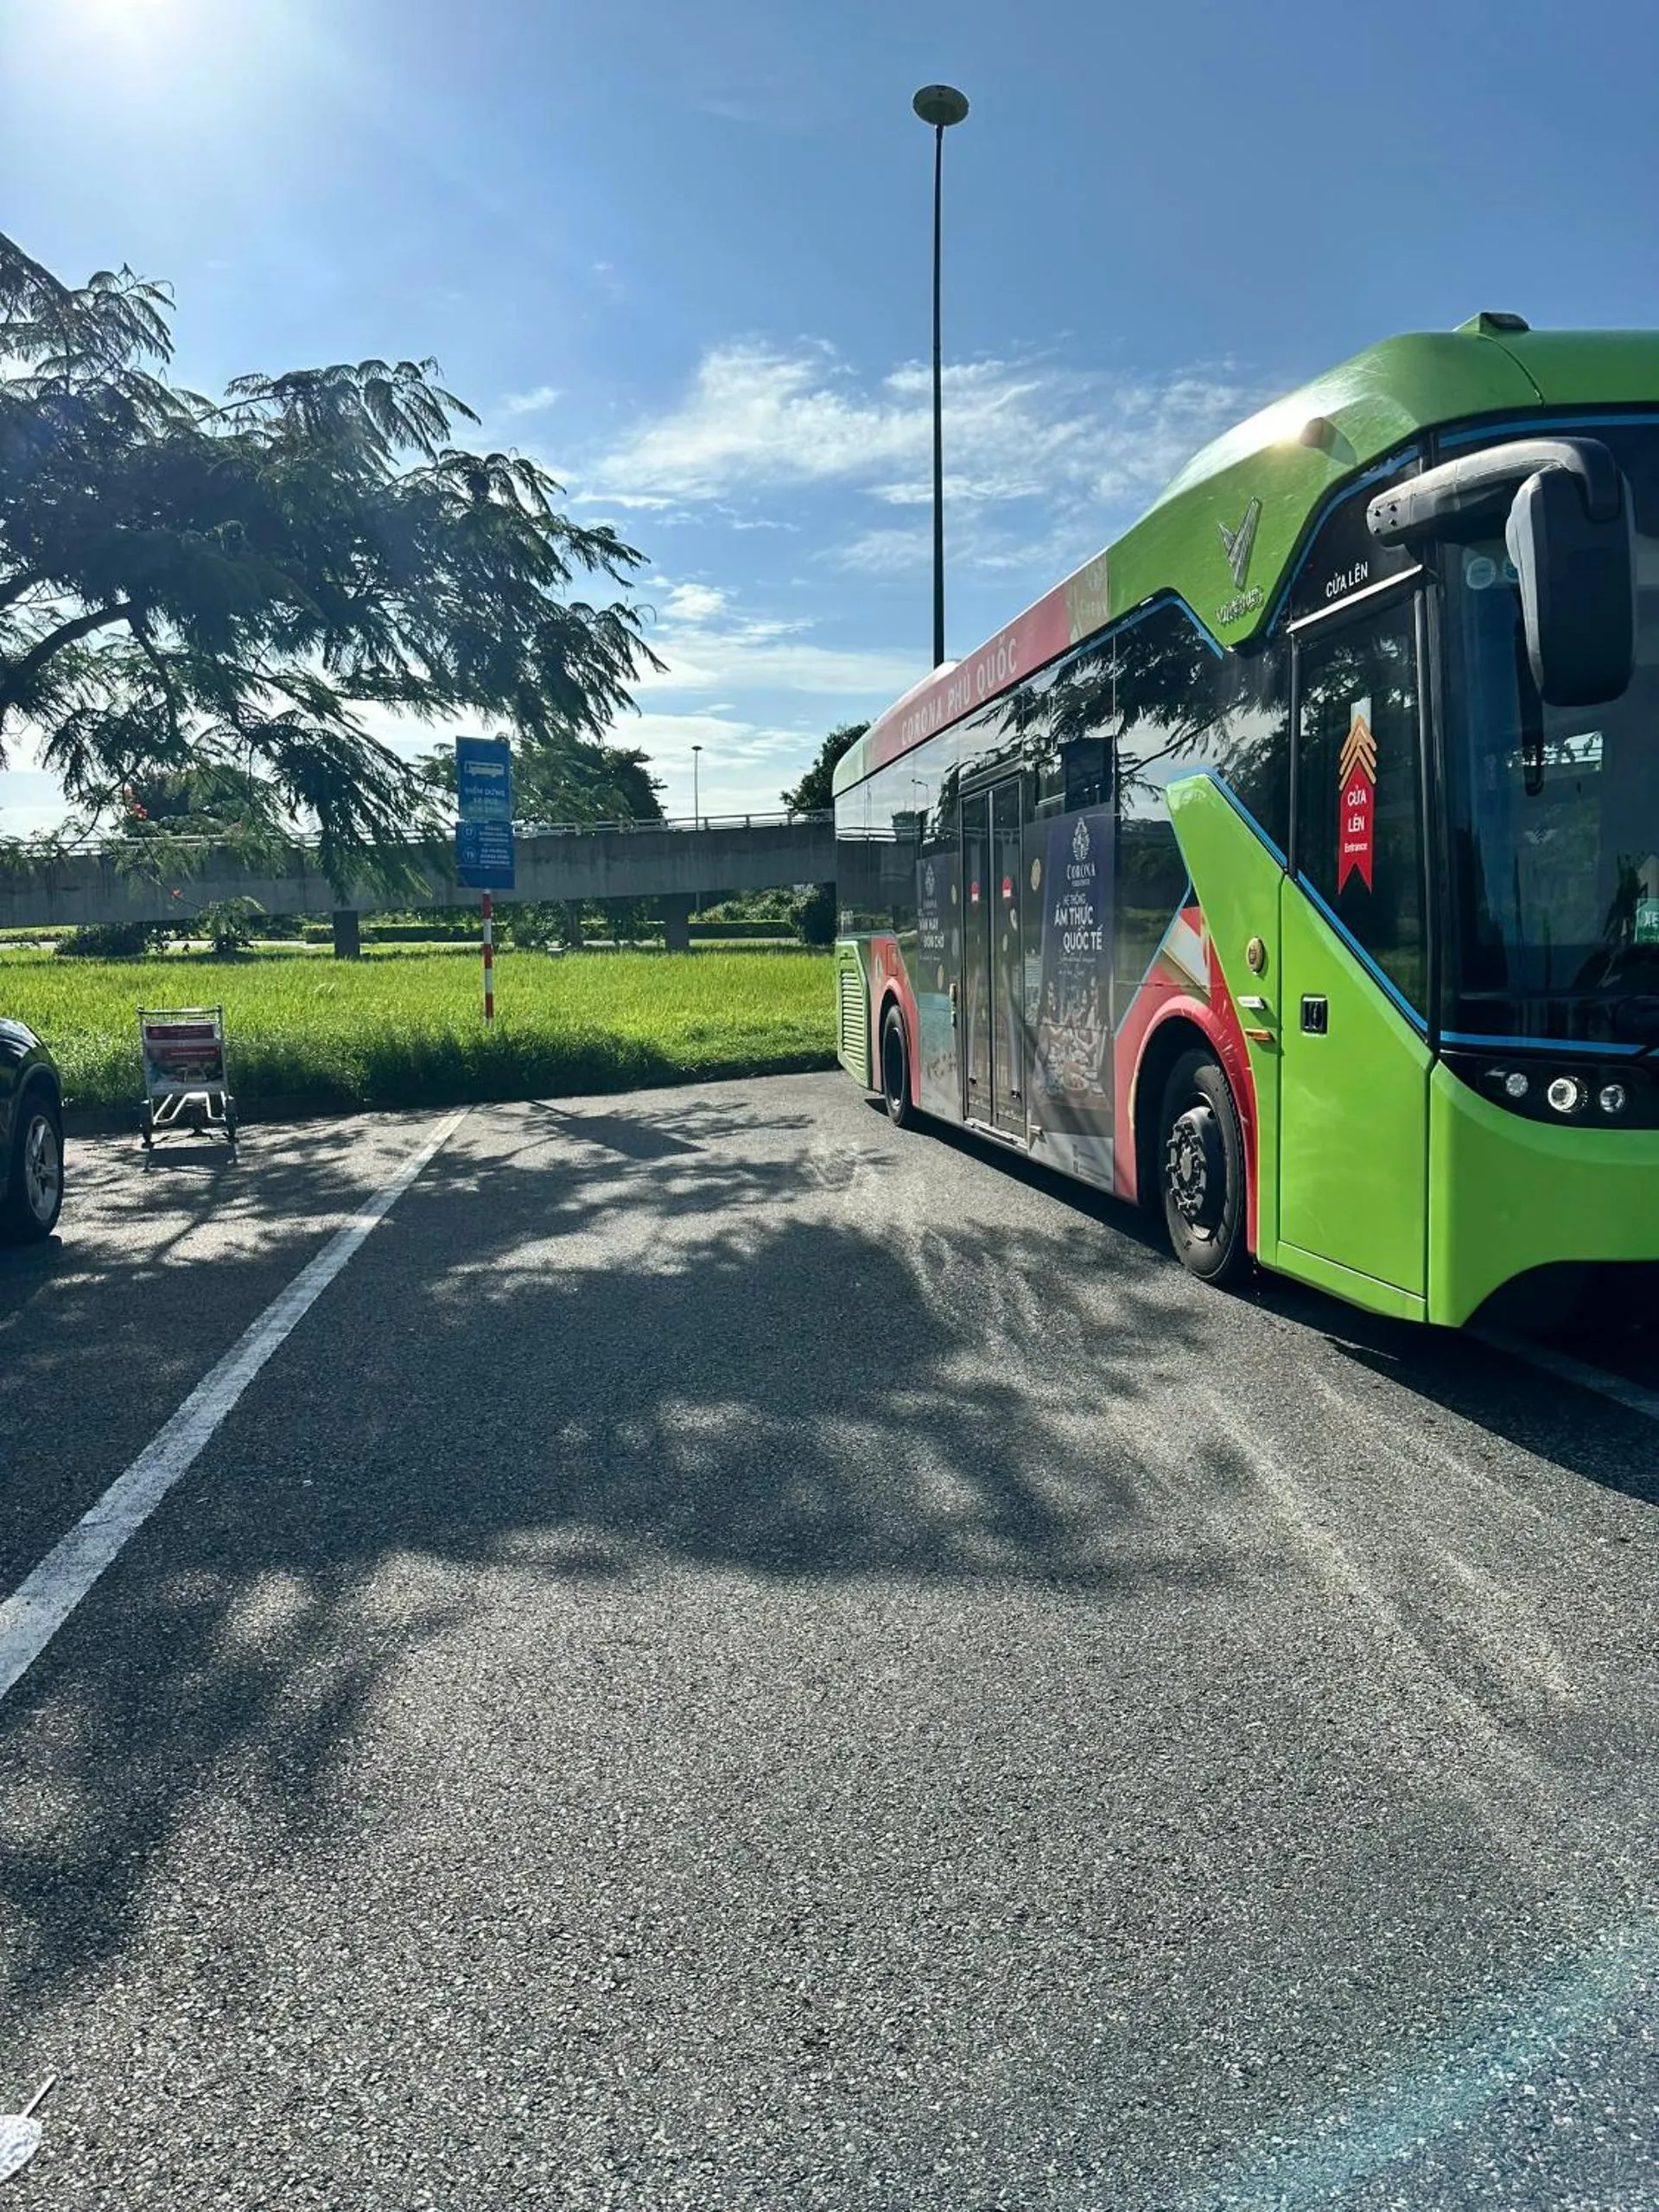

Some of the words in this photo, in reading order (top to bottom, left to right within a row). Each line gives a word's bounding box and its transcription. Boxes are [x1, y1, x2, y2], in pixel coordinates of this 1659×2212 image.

[1325, 571, 1347, 598] CỬA
[1348, 561, 1368, 587] LÊN
[901, 696, 942, 746] CORONA
[947, 662, 971, 720] PHÚ
[976, 634, 1017, 701] QUỐC
[1347, 784, 1367, 807] CỬA
[1347, 813, 1365, 833] LÊN
[1063, 925, 1090, 953] QUỐC
[1090, 924, 1103, 950] TẾ
